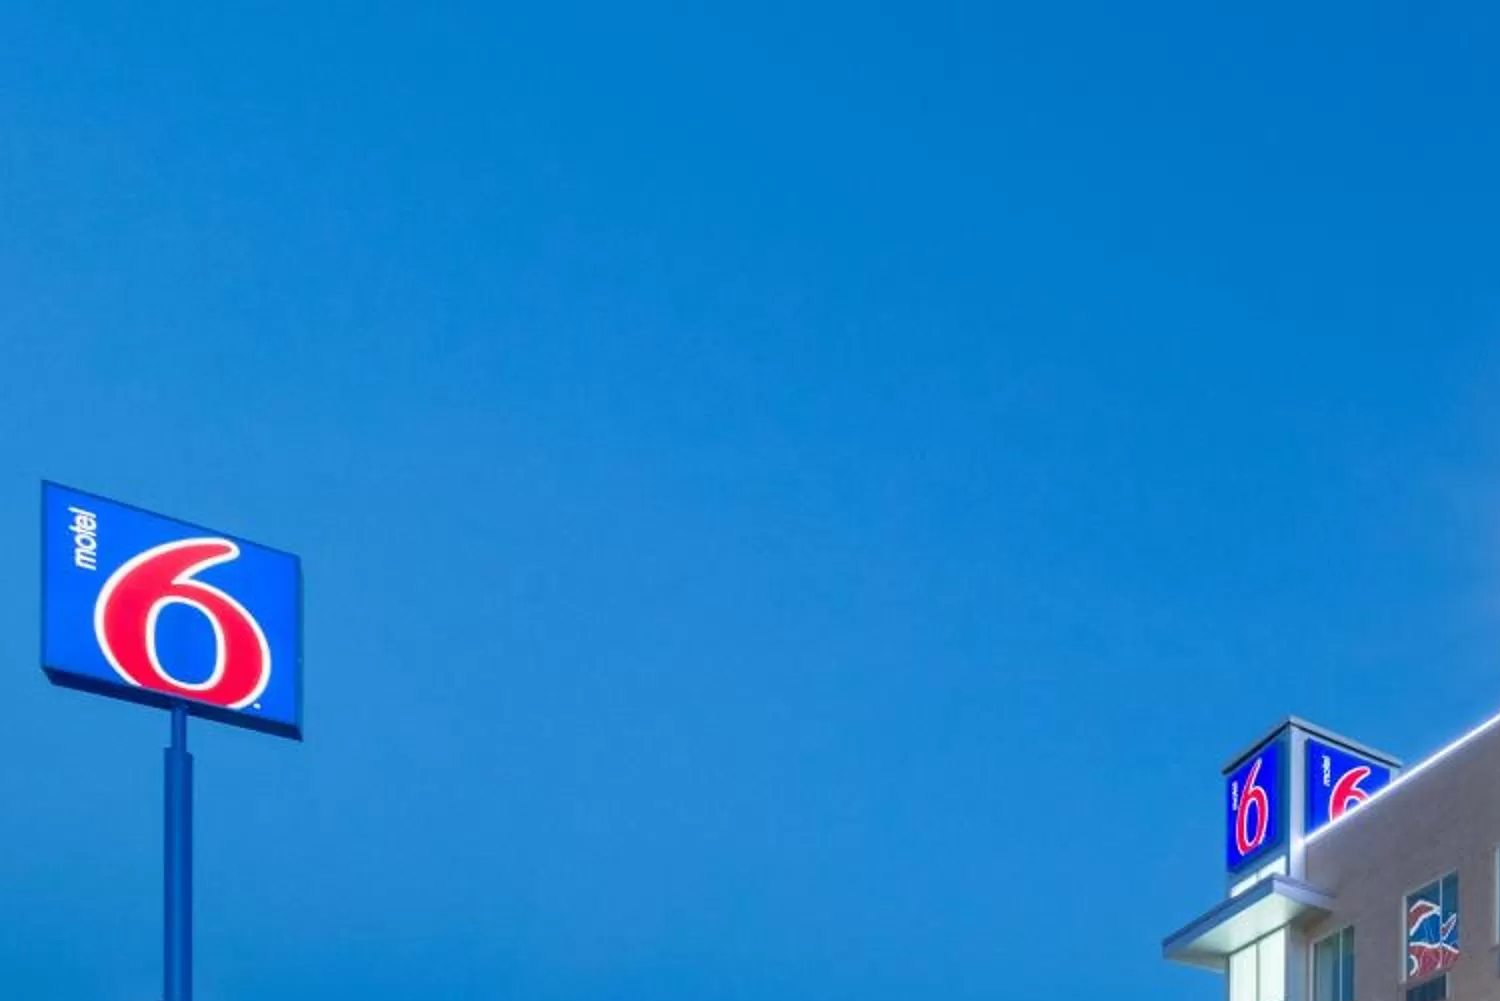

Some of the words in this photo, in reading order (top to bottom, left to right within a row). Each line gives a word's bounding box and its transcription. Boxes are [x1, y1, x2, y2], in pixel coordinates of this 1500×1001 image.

[68, 506, 97, 570] motel
[93, 537, 272, 710] 6
[1235, 757, 1269, 856] 6
[1329, 765, 1372, 824] 6
